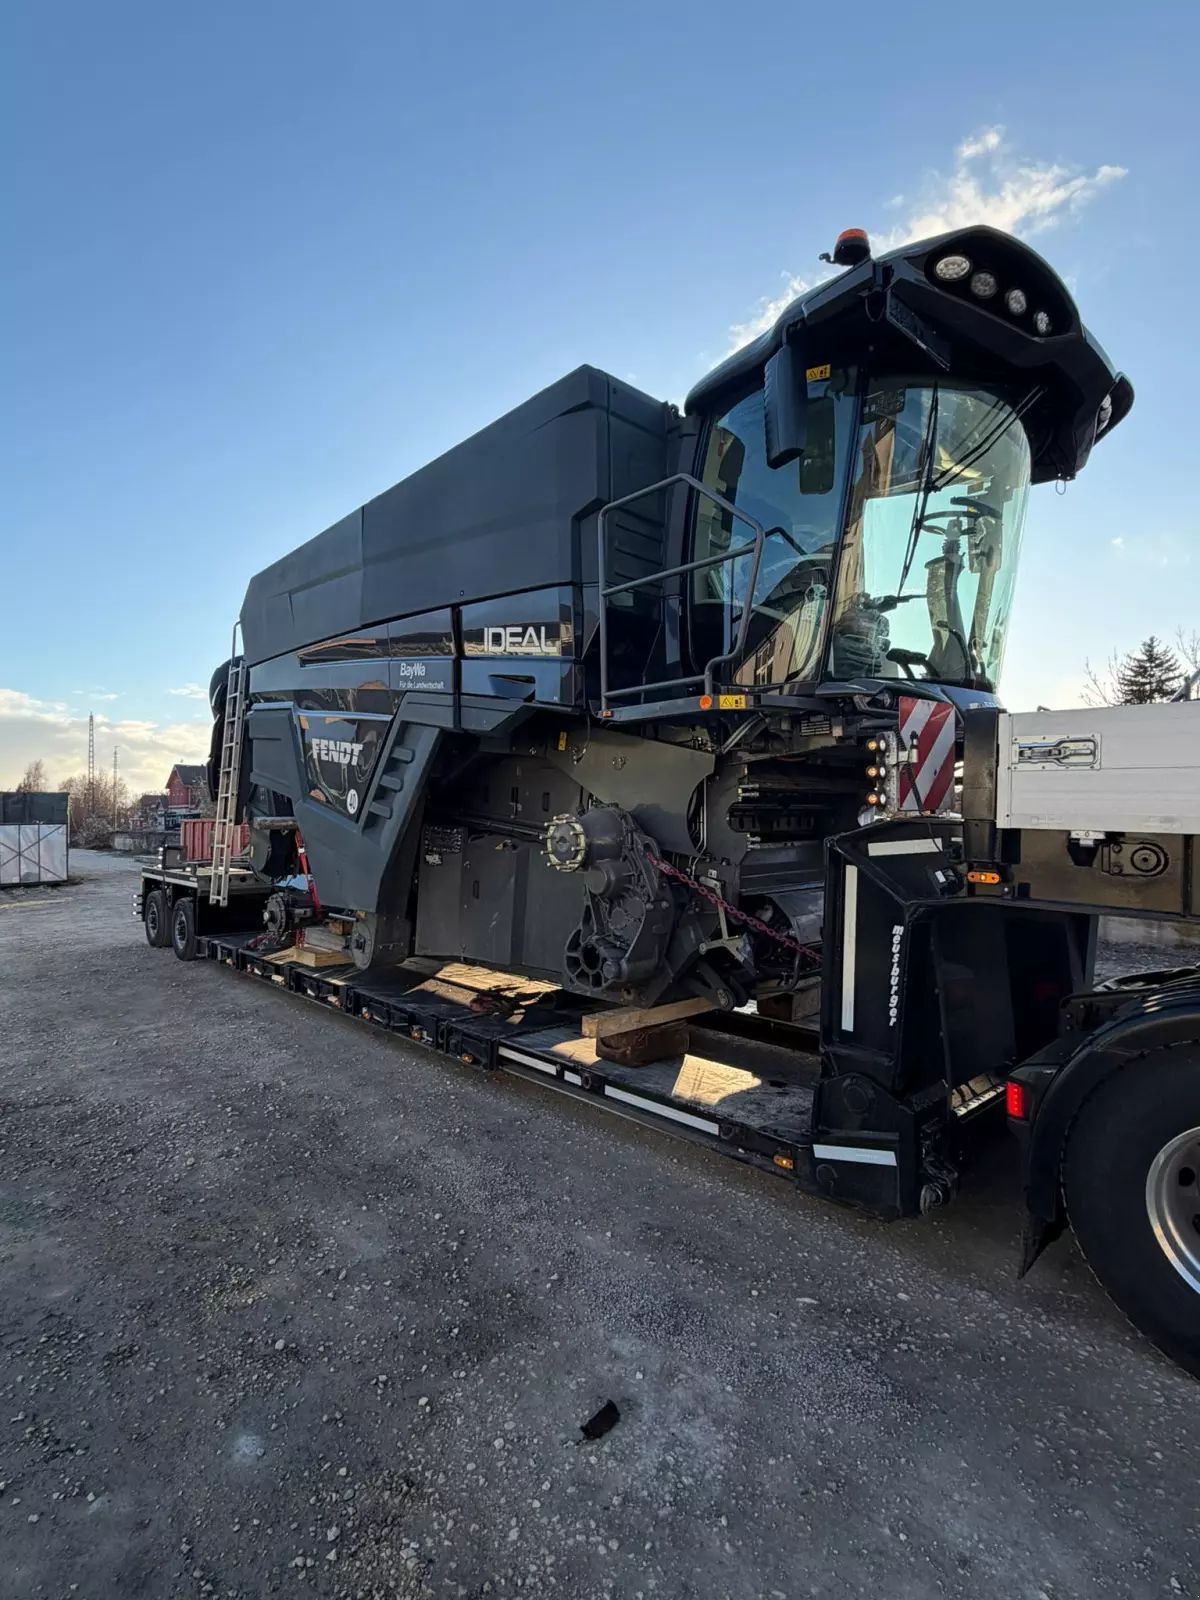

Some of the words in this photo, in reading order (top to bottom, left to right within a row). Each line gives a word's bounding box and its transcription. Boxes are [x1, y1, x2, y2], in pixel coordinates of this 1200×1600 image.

[484, 625, 557, 653] IDEAL
[400, 662, 426, 679] BayWa
[311, 738, 363, 766] FENDT
[889, 924, 904, 1027] meusburger
